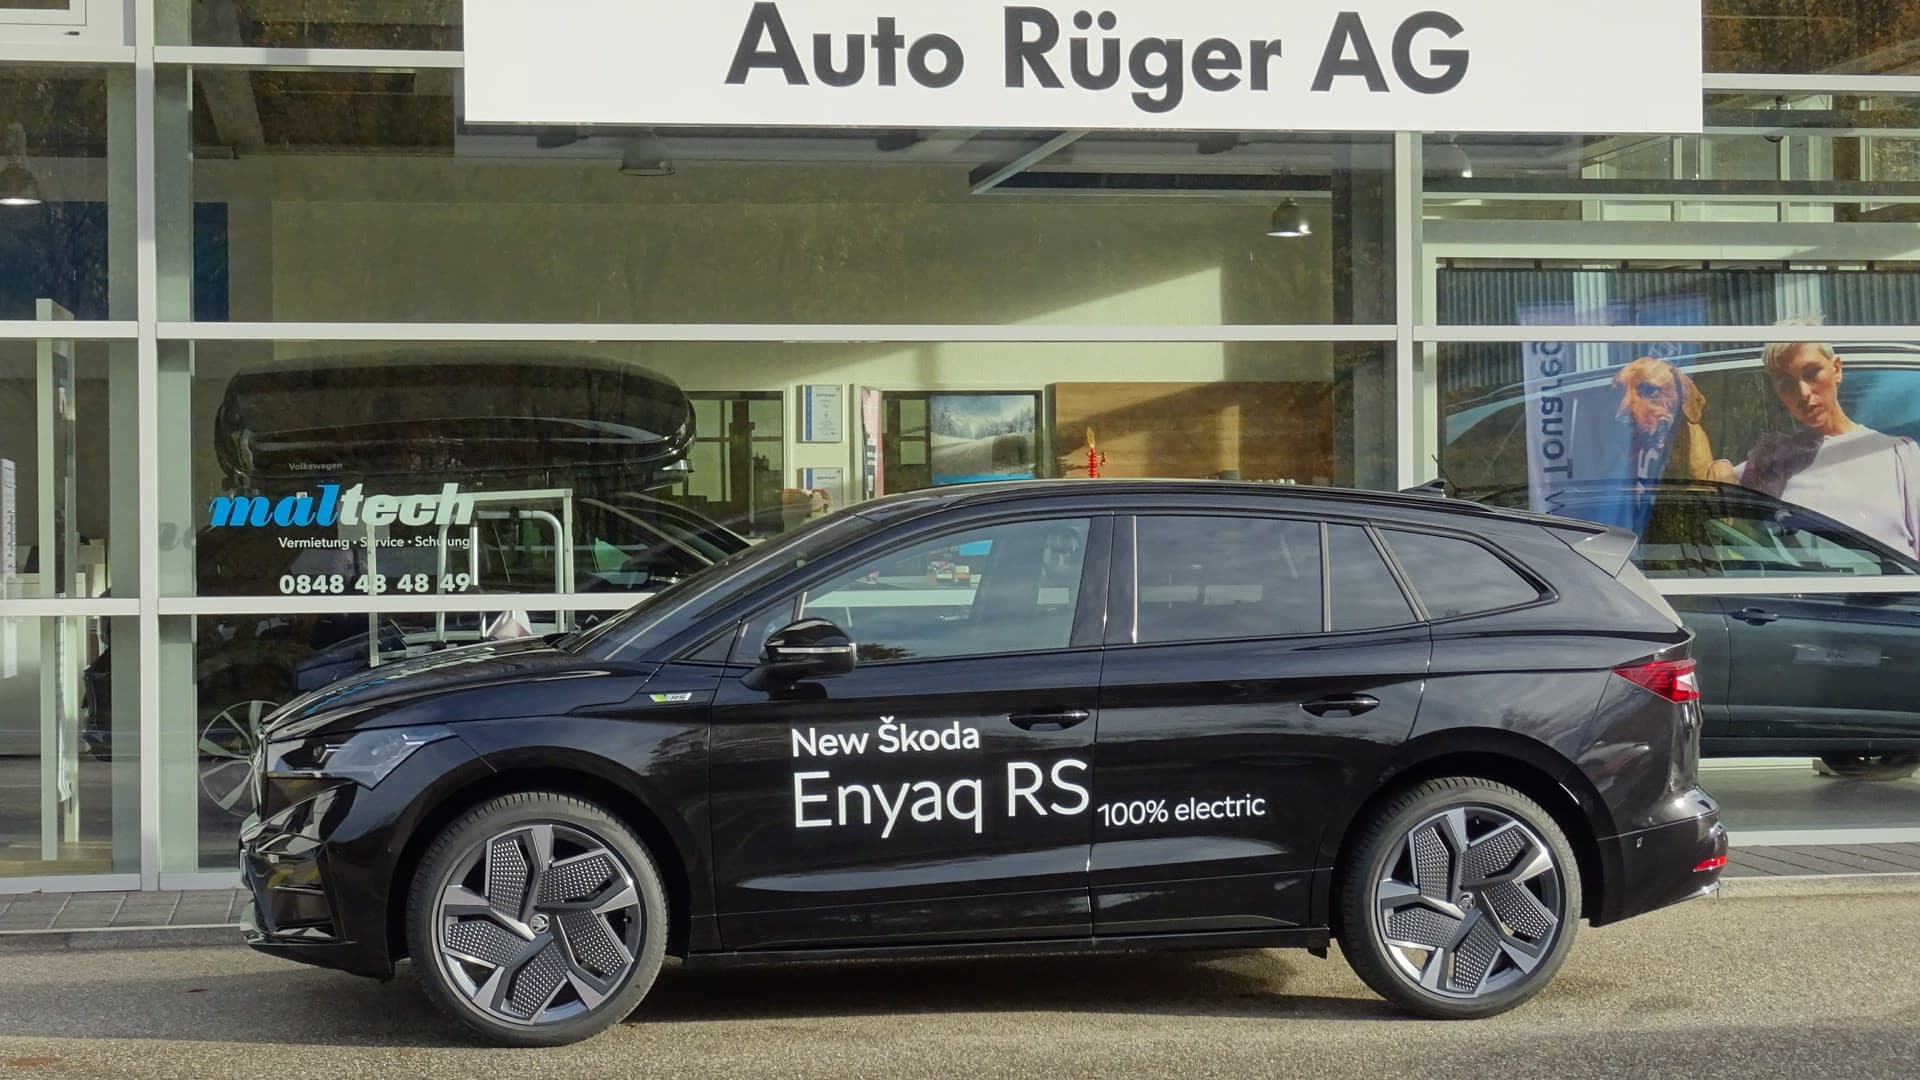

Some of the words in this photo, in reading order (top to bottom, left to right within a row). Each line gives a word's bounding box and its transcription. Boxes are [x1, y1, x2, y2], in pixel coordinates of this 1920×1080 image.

[725, 2, 963, 88] Auto
[1005, 7, 1281, 113] Rüger
[1311, 11, 1469, 94] AG
[288, 461, 343, 472] Volkswagen
[208, 483, 474, 528] maltech
[278, 537, 350, 550] Vermietung
[360, 536, 405, 548] Srvice
[414, 535, 471, 550] Schuung
[279, 574, 344, 594] 0848
[354, 573, 387, 593] 48
[397, 573, 429, 593] 48
[440, 572, 471, 592] 49
[792, 728, 869, 757] New
[878, 716, 979, 752] Škoda
[794, 771, 982, 838] Enyaq
[1008, 759, 1089, 816] RS
[1097, 800, 1169, 827] 100%
[1175, 793, 1266, 820] electric
